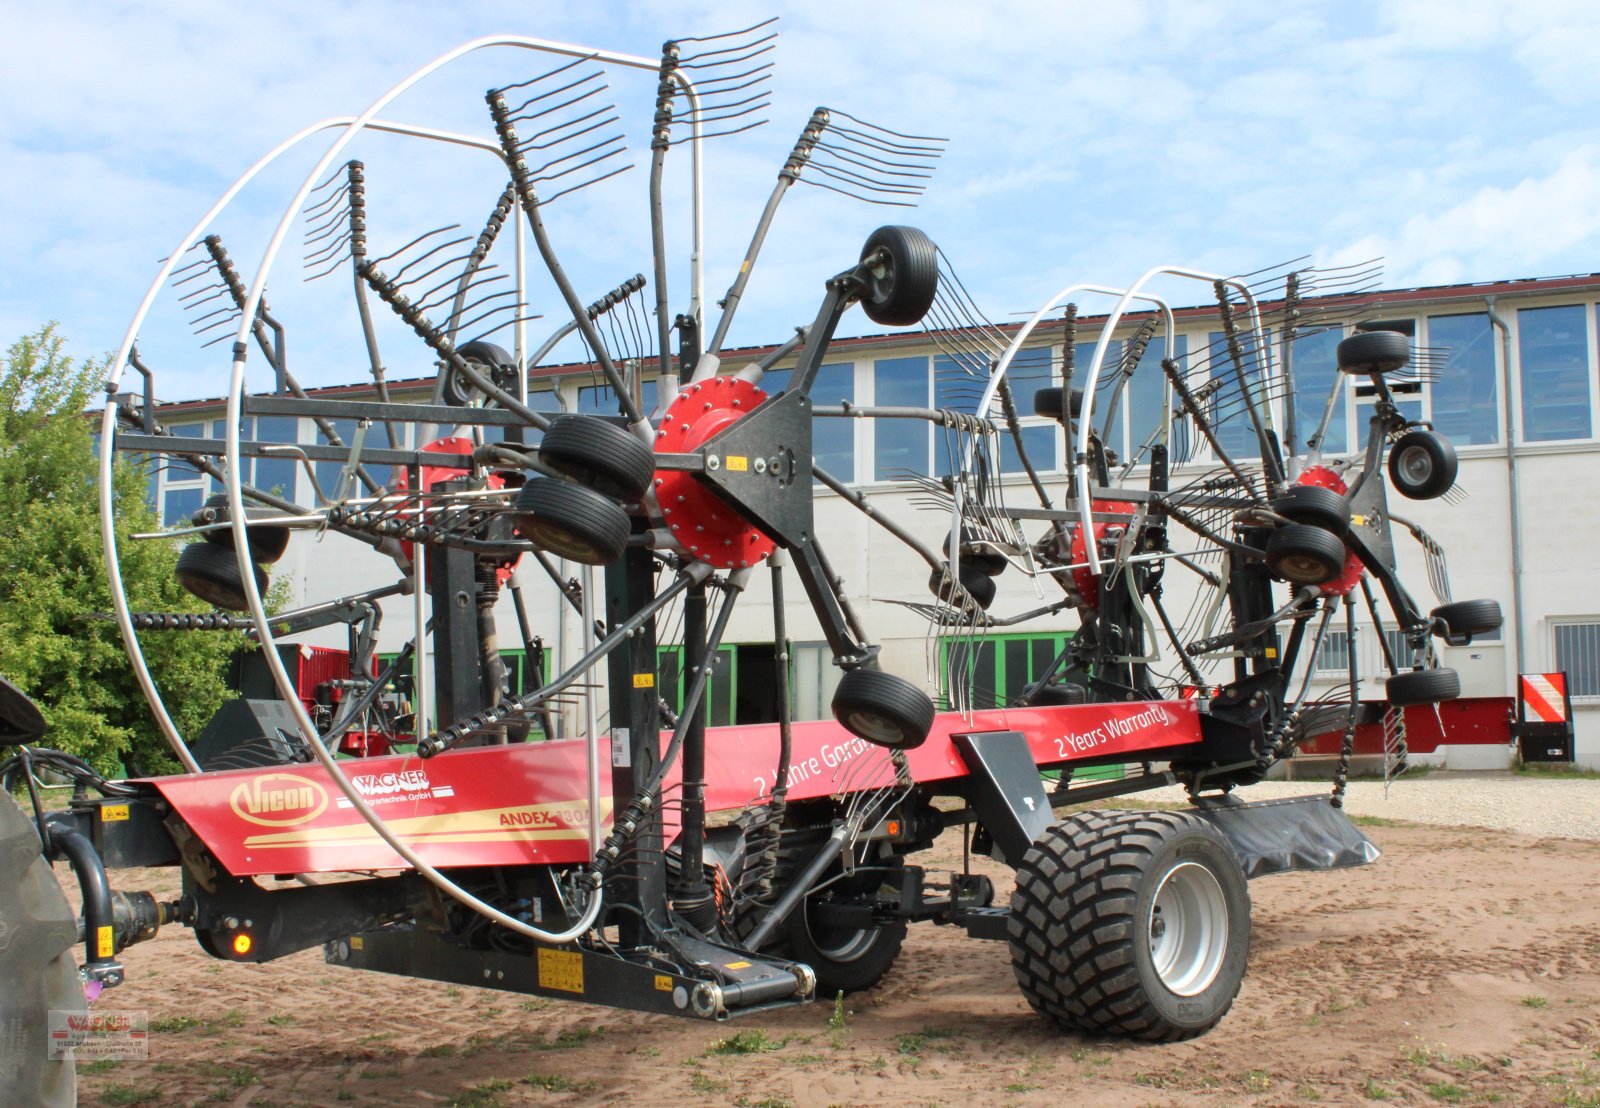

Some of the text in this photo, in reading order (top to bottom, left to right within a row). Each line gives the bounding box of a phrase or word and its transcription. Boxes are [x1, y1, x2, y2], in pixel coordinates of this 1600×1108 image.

[1054, 706, 1169, 759] 2 Years Warranty
[352, 769, 430, 795] WAGNER
[753, 777, 766, 800] 2
[238, 775, 315, 814] Vicon
[408, 791, 431, 801] GmbH
[500, 811, 550, 826] ANDEX
